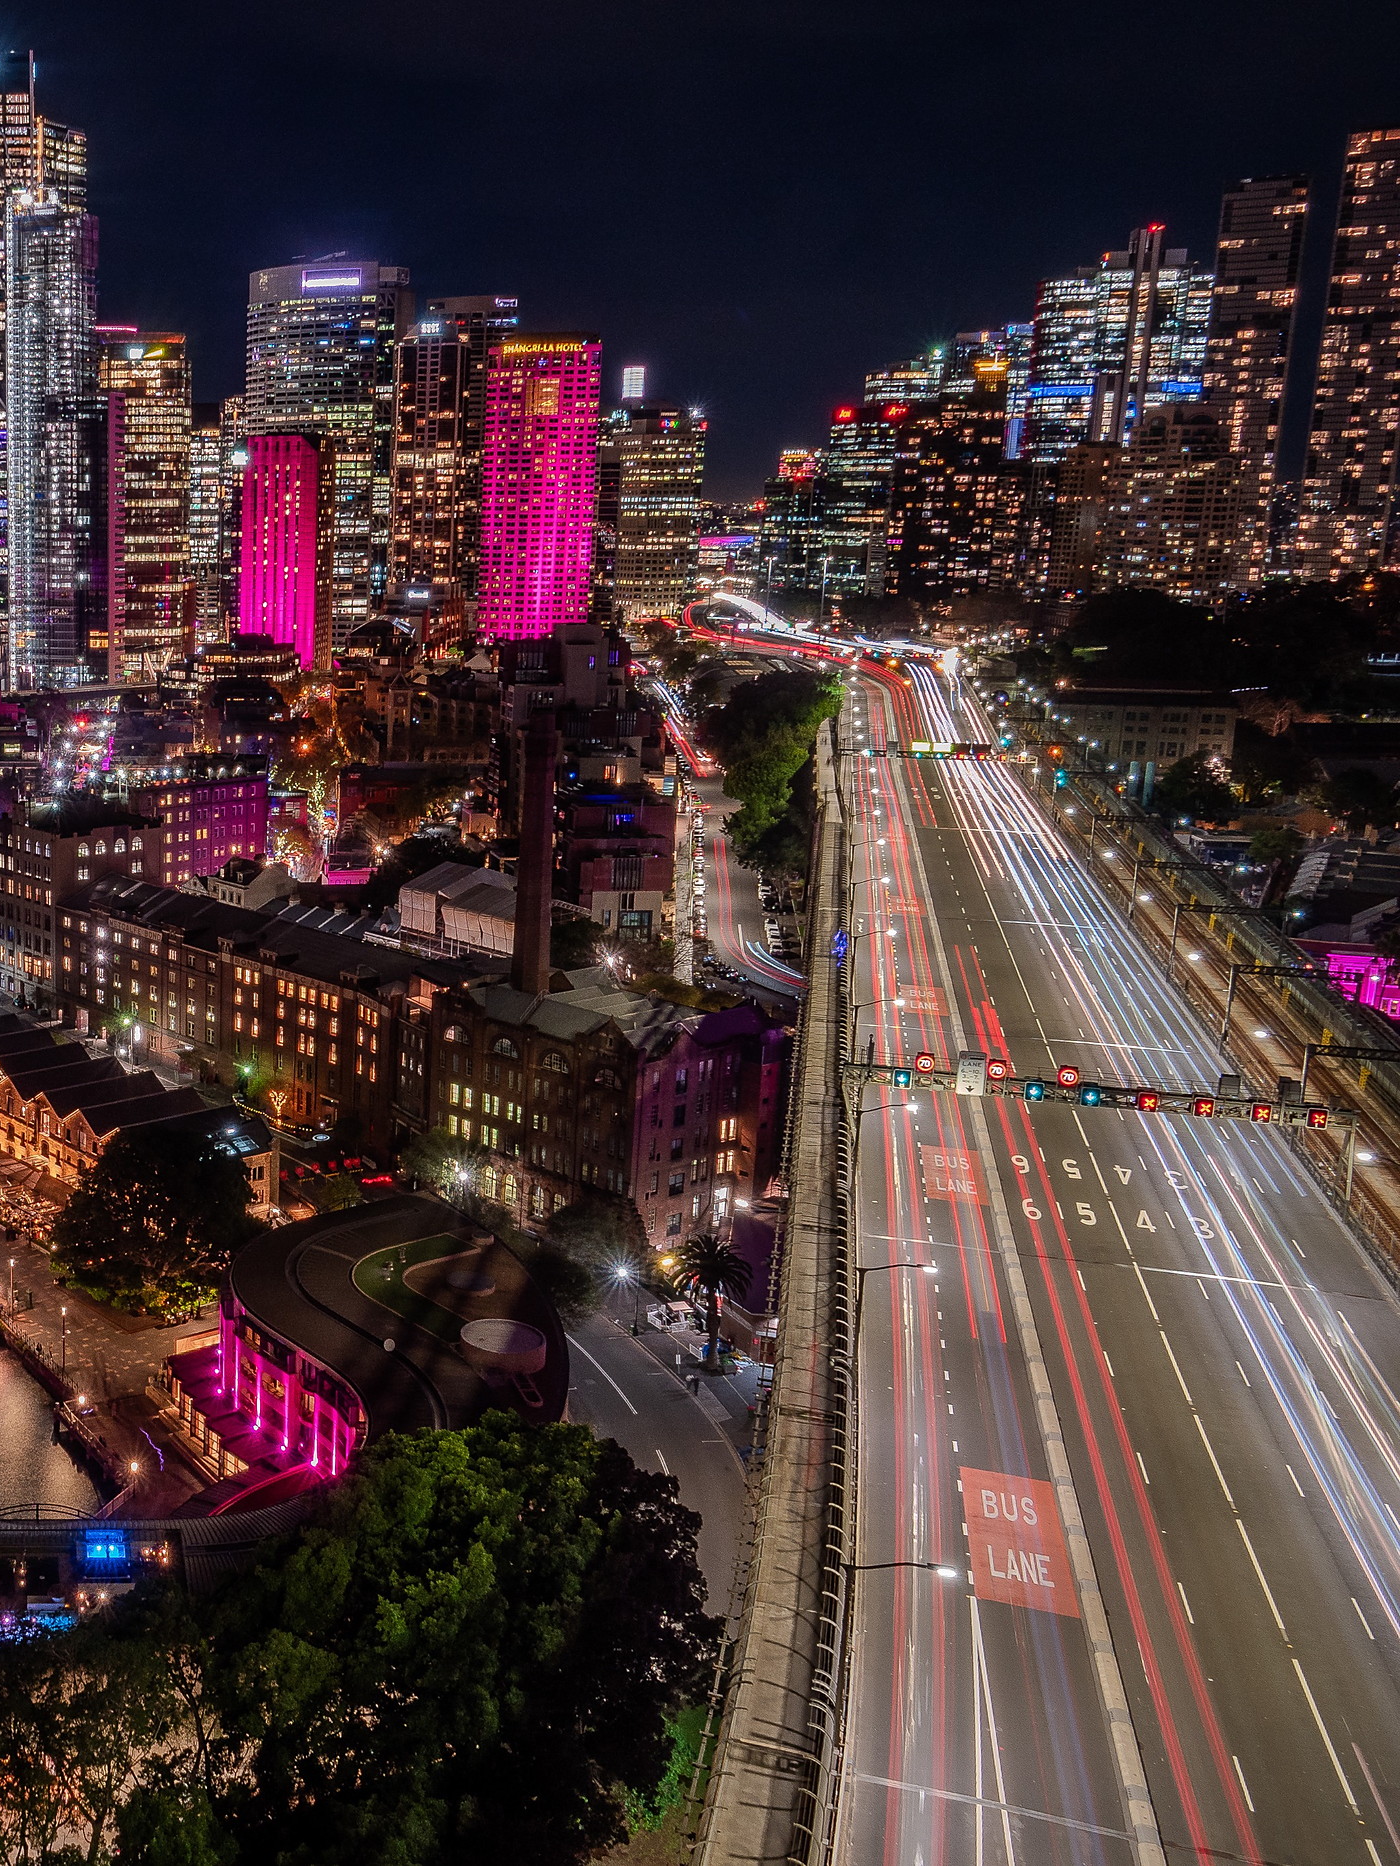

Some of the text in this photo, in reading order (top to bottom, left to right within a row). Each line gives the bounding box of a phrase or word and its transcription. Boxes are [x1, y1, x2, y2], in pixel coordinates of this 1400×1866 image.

[503, 343, 583, 354] SHANGRI-LA HOTEL
[234, 957, 259, 969] BOND
[909, 989, 935, 998] BUS
[358, 994, 378, 1009] BOND
[910, 1000, 939, 1011] LANE
[920, 1059, 931, 1068] 70
[991, 1066, 1002, 1074] 70
[934, 1154, 970, 1170] BUS
[936, 1176, 977, 1195] LANE
[1022, 1198, 1215, 1240] 6 5 4 3
[981, 1489, 1038, 1526] BUS
[986, 1544, 1055, 1588] LANE
